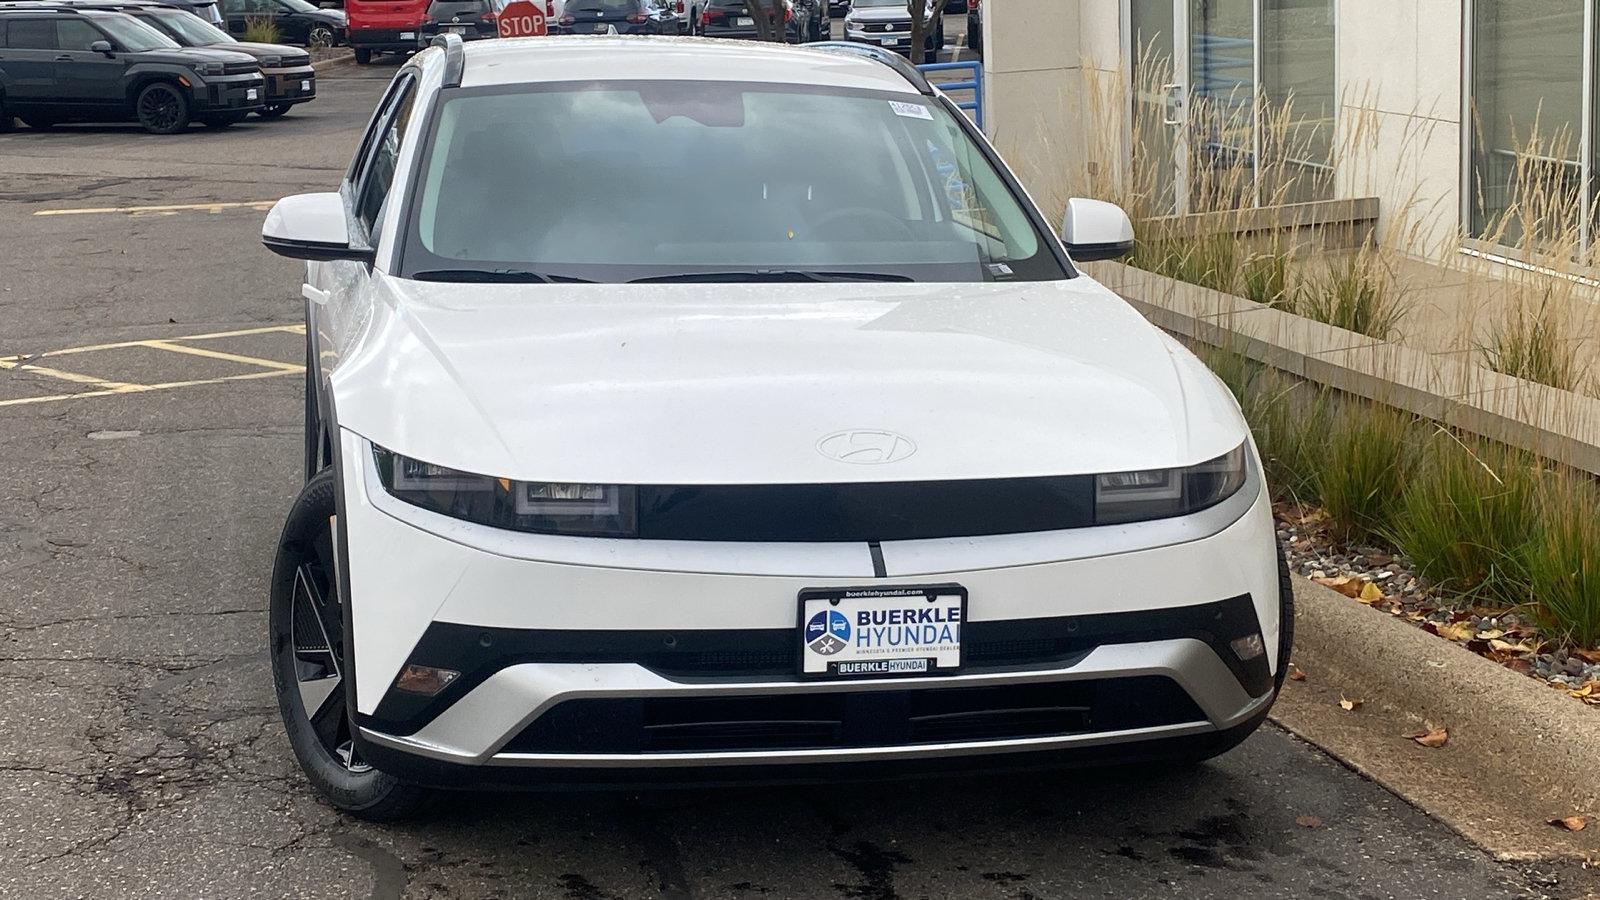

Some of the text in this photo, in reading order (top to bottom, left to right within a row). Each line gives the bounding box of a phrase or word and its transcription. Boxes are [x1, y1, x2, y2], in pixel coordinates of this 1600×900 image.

[501, 15, 544, 36] STOP
[846, 590, 924, 598] buerklehyundai.com
[857, 607, 960, 626] BUERKLE
[856, 624, 960, 648] HYUNDAI
[840, 660, 926, 673] BUERKLE HYUNDAI
